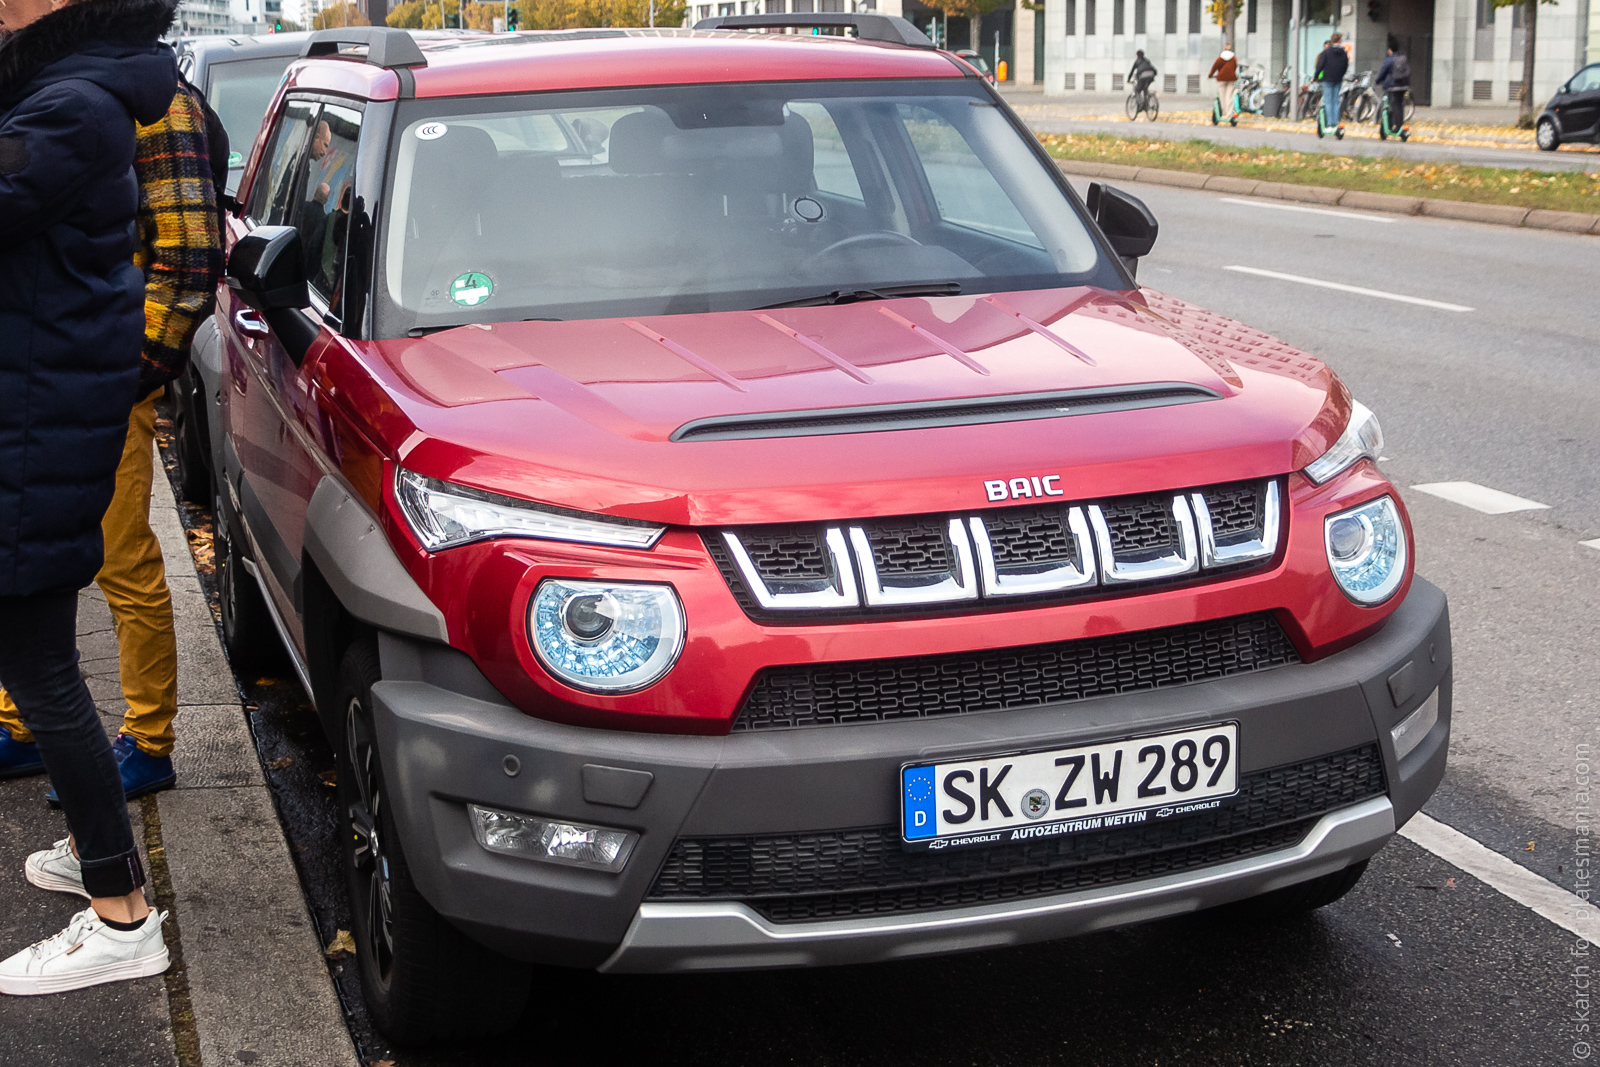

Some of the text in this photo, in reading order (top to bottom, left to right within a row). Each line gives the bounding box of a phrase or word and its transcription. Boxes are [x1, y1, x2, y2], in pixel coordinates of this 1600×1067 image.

[465, 273, 477, 288] 4
[983, 474, 1064, 502] BAIC
[942, 764, 1014, 825] SK
[1054, 750, 1123, 811] ZW
[1137, 734, 1231, 799] 289
[914, 810, 927, 828] D
[951, 800, 1221, 846] CHEVROLET AUTOZENTRUM WETTIN CHEVROLET
